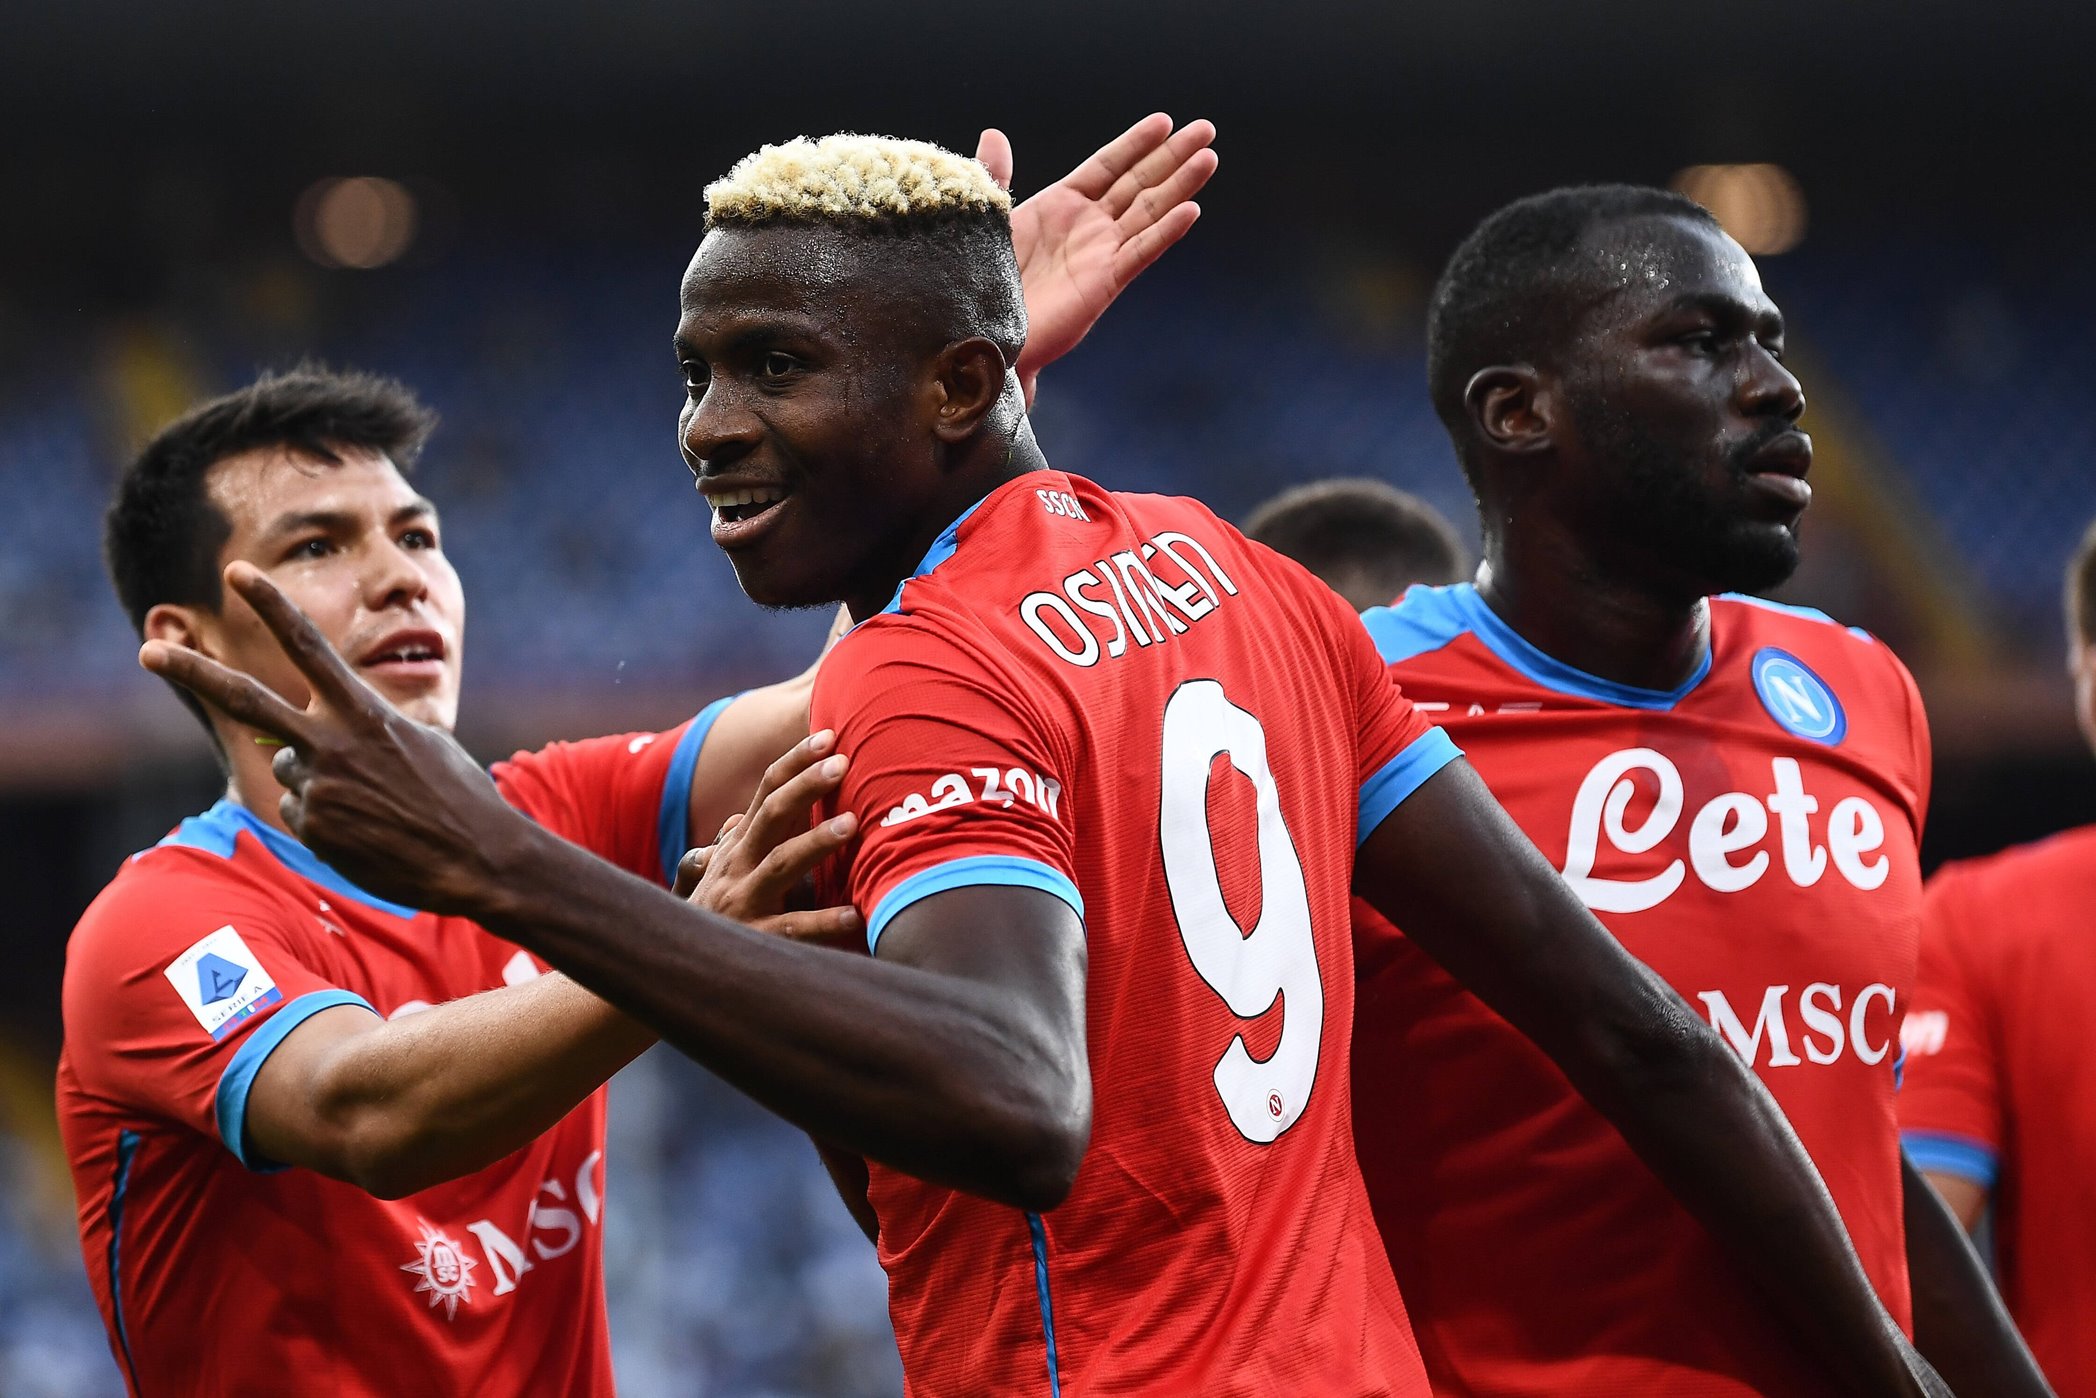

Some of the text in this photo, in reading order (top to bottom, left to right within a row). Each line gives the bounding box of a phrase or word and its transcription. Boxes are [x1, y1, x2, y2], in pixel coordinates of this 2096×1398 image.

[1036, 489, 1090, 522] SSCN
[1769, 675, 1822, 723] N
[1562, 747, 1890, 914] Lete
[1160, 678, 1324, 1145] 9
[1697, 983, 1895, 1067] MSC
